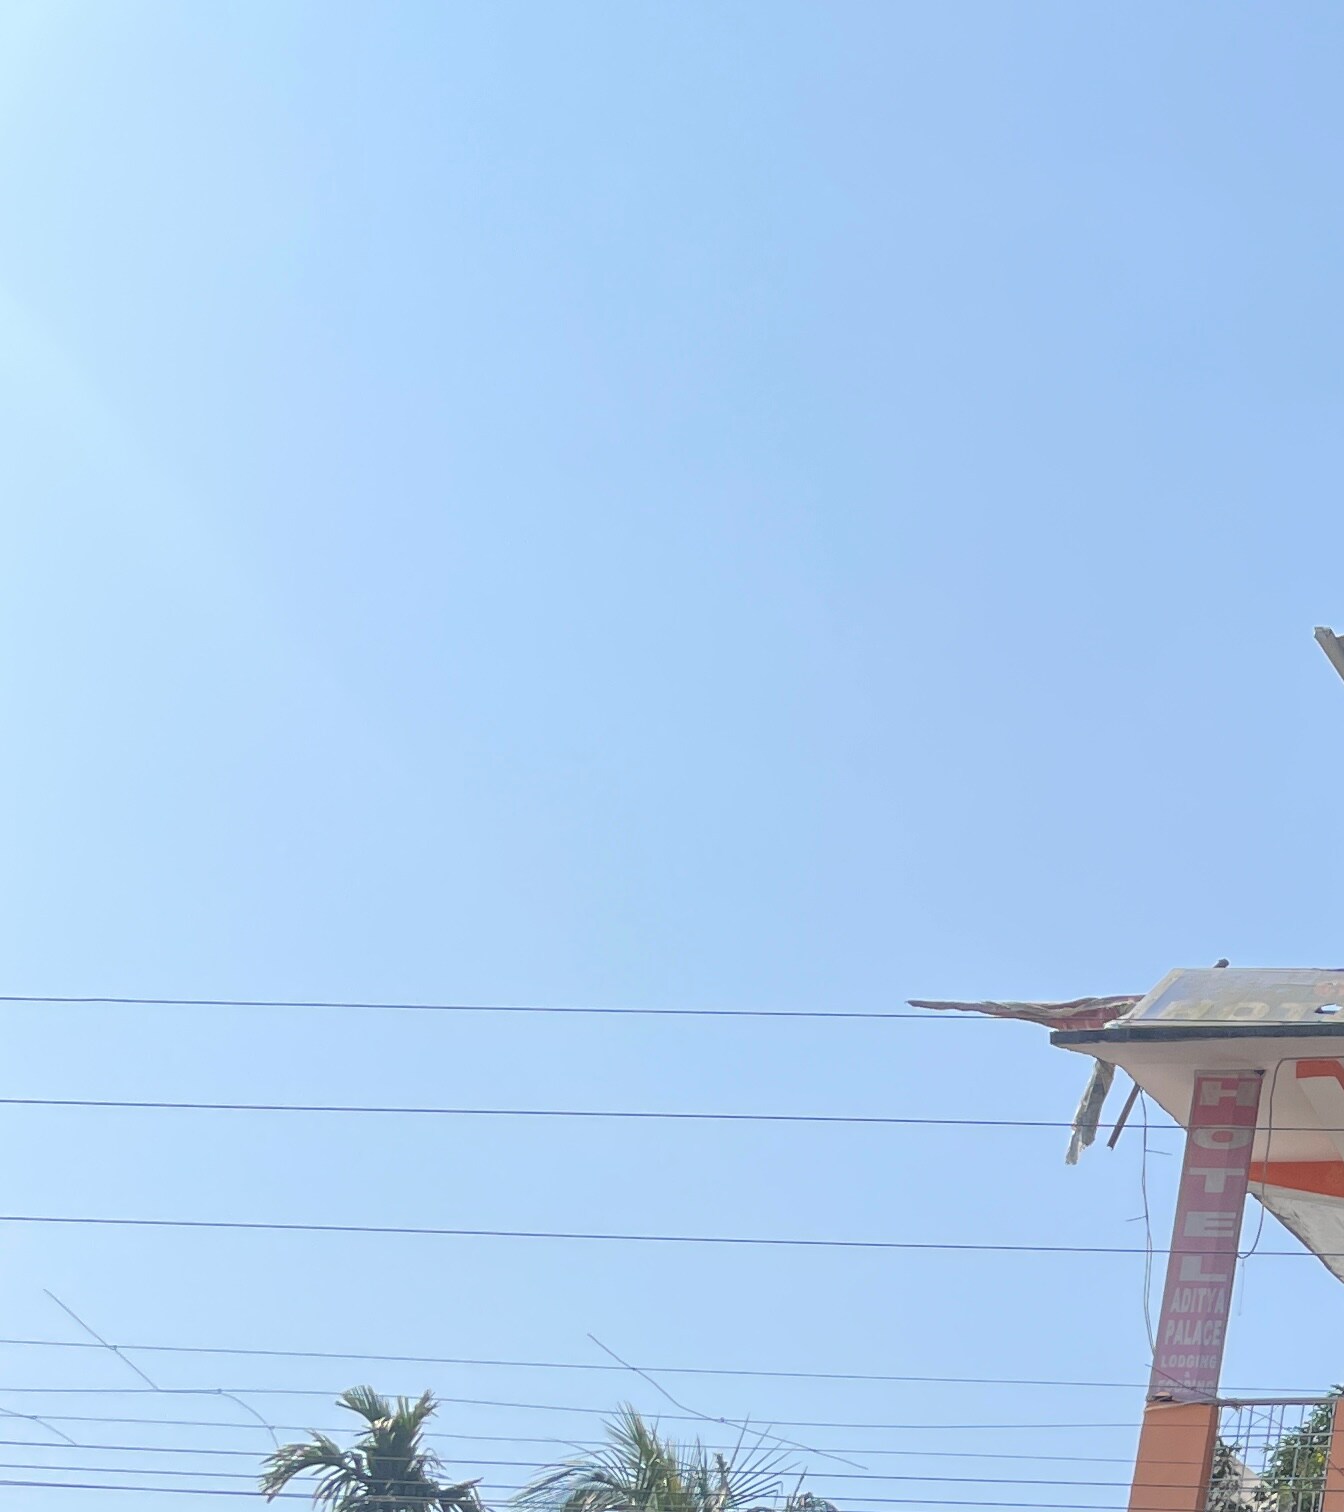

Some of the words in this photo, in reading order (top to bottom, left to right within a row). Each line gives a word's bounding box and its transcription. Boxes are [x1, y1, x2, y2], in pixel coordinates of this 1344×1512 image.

[1179, 1081, 1258, 1282] HOTEL
[1170, 1287, 1225, 1313] ADITYA
[1164, 1319, 1223, 1346] PALACE
[1161, 1354, 1217, 1369] LODGING
